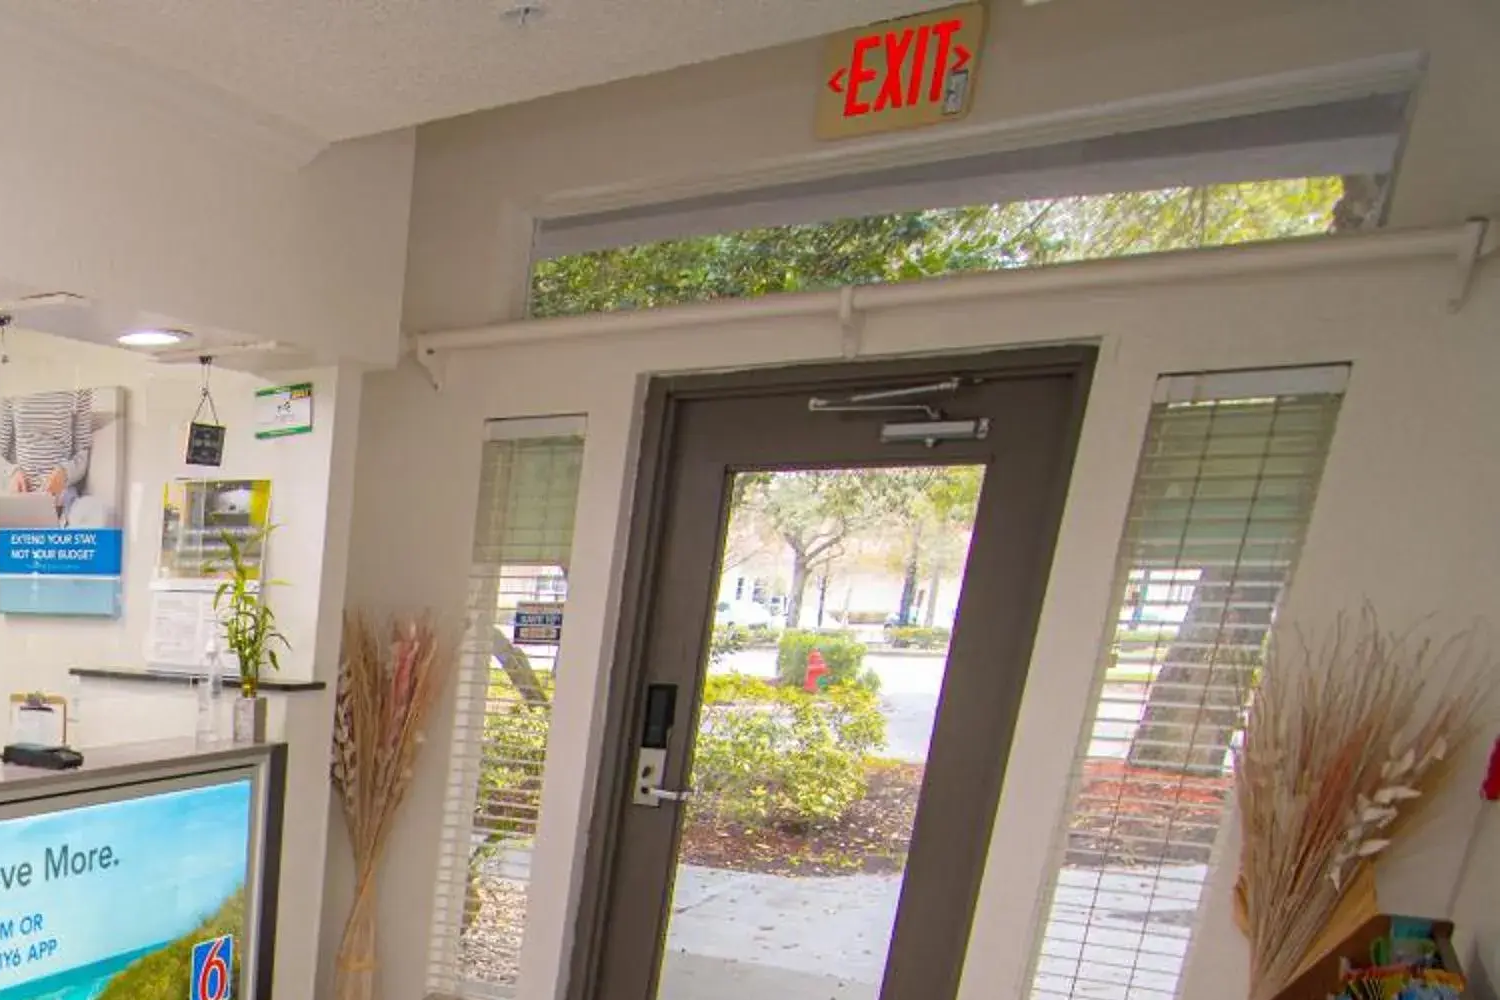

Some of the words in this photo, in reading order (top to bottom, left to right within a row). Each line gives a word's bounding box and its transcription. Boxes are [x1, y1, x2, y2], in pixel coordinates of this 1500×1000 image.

[843, 20, 963, 118] EXIT
[10, 533, 45, 545] EXTEND
[47, 533, 73, 545] YOUR
[10, 549, 30, 559] NOT
[31, 549, 57, 560] YOUR
[58, 549, 96, 560] BUDGET
[44, 844, 120, 881] More.
[19, 913, 44, 935] OR
[27, 938, 58, 962] APP
